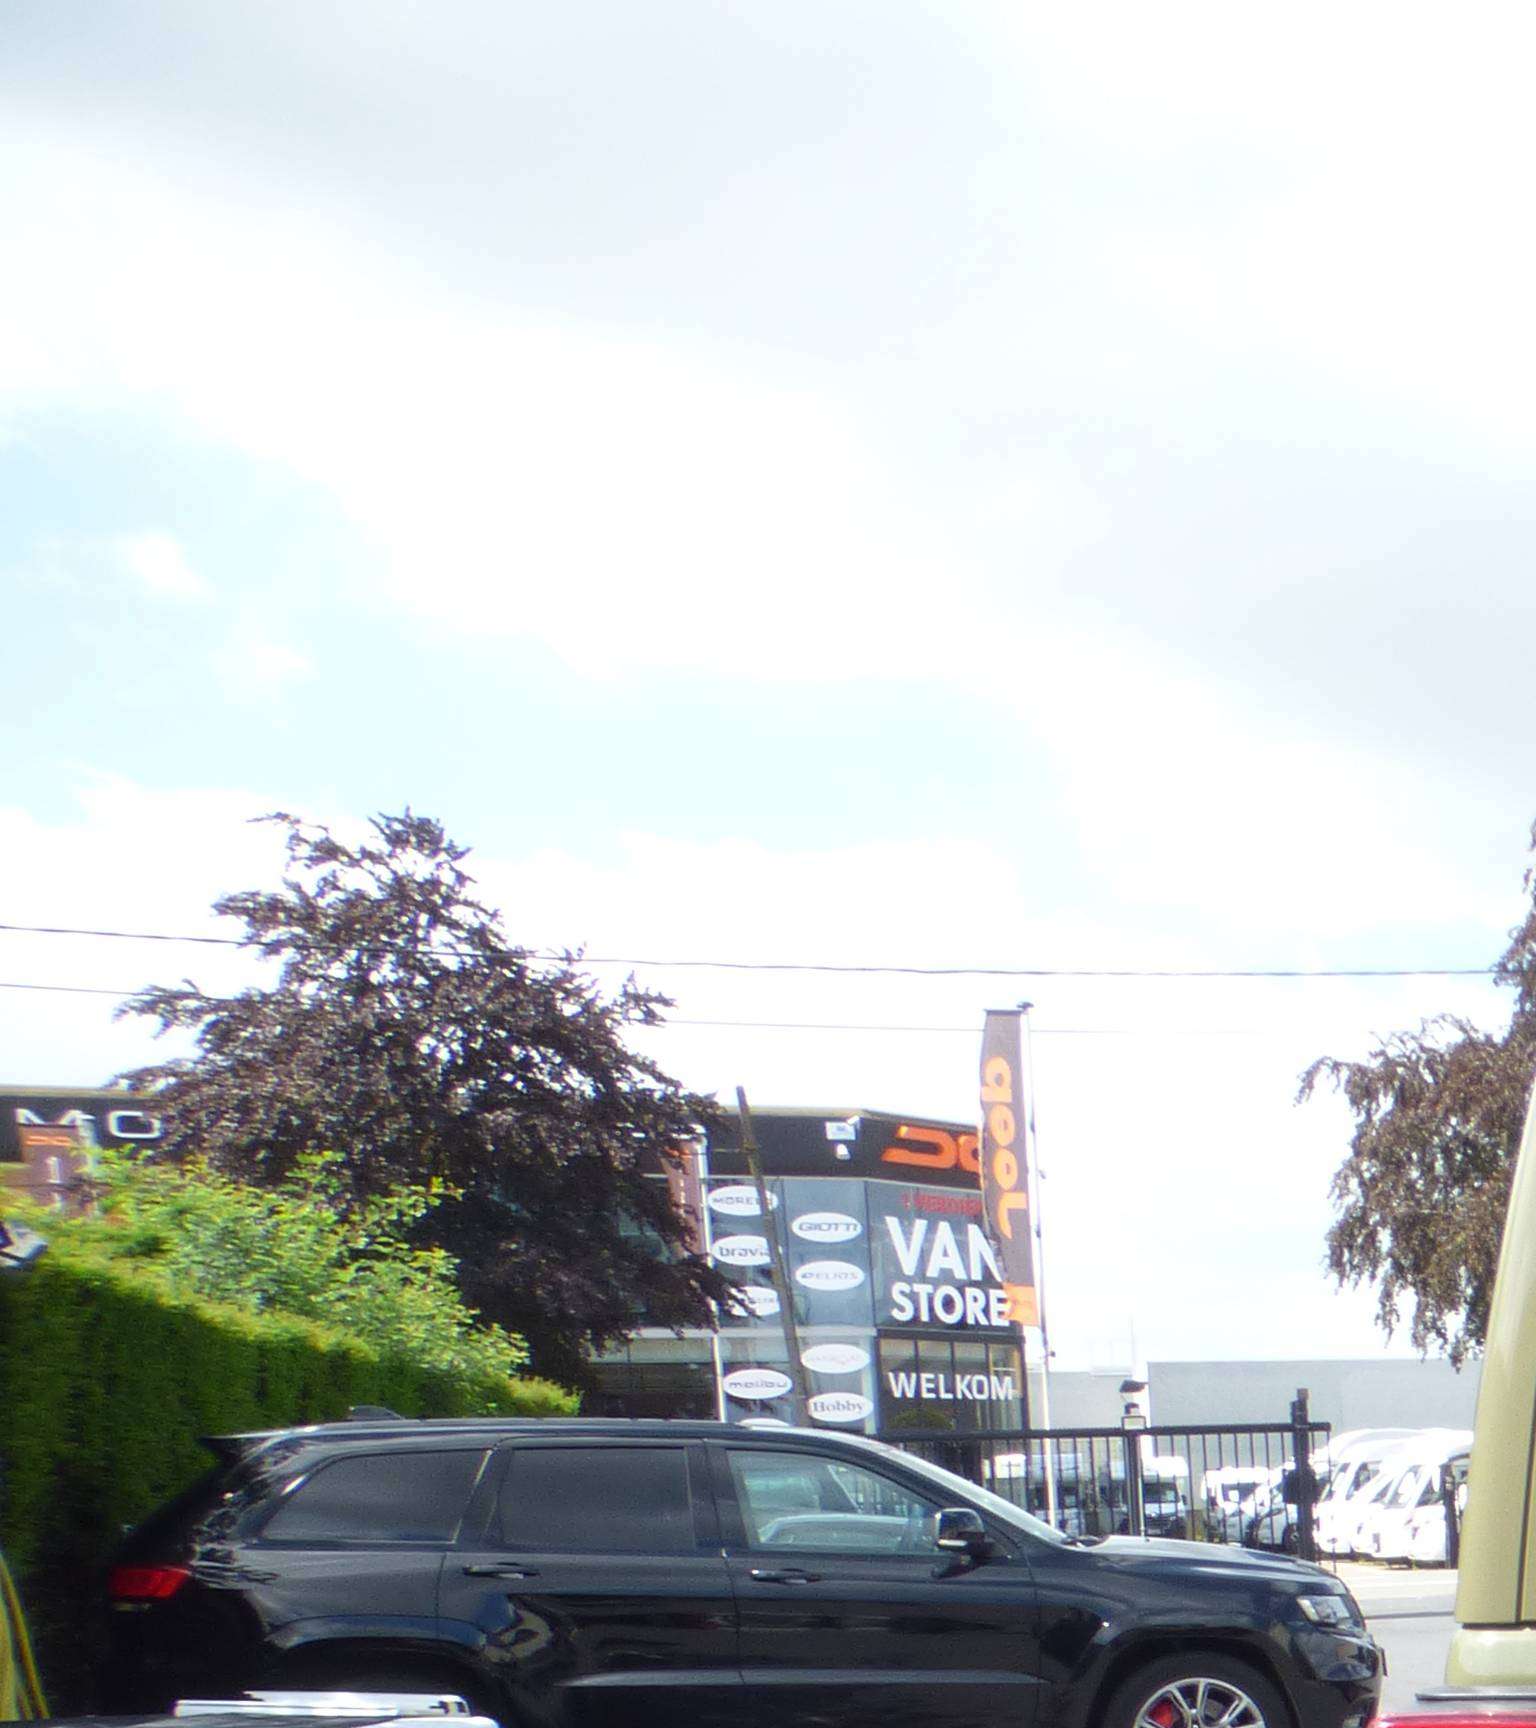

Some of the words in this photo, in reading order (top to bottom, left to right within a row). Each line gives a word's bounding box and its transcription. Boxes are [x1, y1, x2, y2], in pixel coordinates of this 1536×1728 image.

[885, 1215, 1003, 1283] VAN
[891, 1281, 1012, 1327] STORE
[887, 1370, 1014, 1401] WELKOM
[812, 1400, 865, 1415] Hobby
